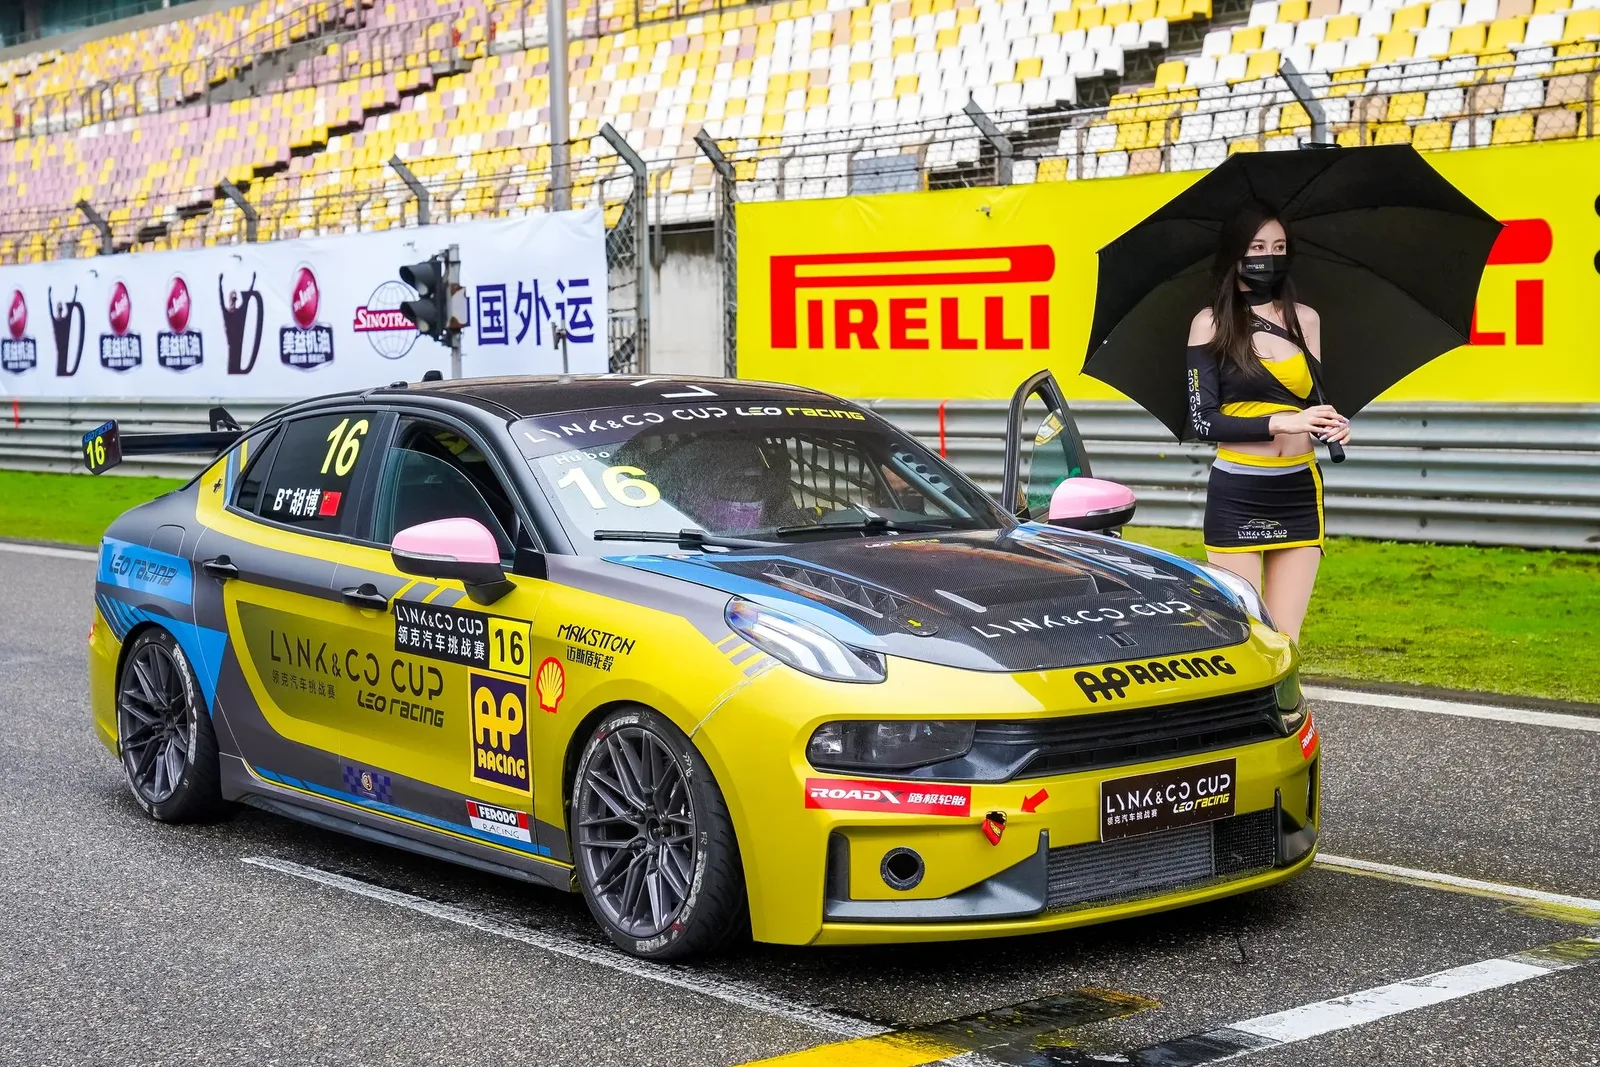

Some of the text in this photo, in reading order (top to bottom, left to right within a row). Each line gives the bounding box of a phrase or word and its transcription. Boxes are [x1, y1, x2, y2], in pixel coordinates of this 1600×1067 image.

[467, 278, 594, 346] 国外运
[769, 244, 1056, 350] PIRELLI
[355, 309, 416, 329] SINOTRA
[524, 406, 866, 444] LYNK&CO CUP LEO racing
[86, 436, 105, 470] 16
[320, 418, 369, 477] 16
[557, 465, 661, 510] 16
[395, 604, 484, 636] LYNK&CO CUP
[971, 600, 1192, 639] LYNK&CO CUP
[397, 625, 485, 661] 领克汽车挑战赛
[494, 628, 525, 666] 16
[270, 630, 444, 701] LYNK&CO CUP
[272, 669, 336, 699] 领克汽车挑战赛
[1074, 654, 1237, 704] AP RACING
[357, 690, 445, 728] LEO racing
[474, 686, 524, 752] AP
[477, 748, 526, 780] RACING
[810, 787, 905, 805] ROADX
[907, 792, 966, 806] 路极轮胎
[1106, 773, 1231, 814] LYNK&CO CUP
[1173, 793, 1230, 814] LEO racing
[478, 806, 517, 826] FERODO
[482, 823, 520, 839] RACING
[1107, 808, 1158, 826] 领克汽车挑战赛
